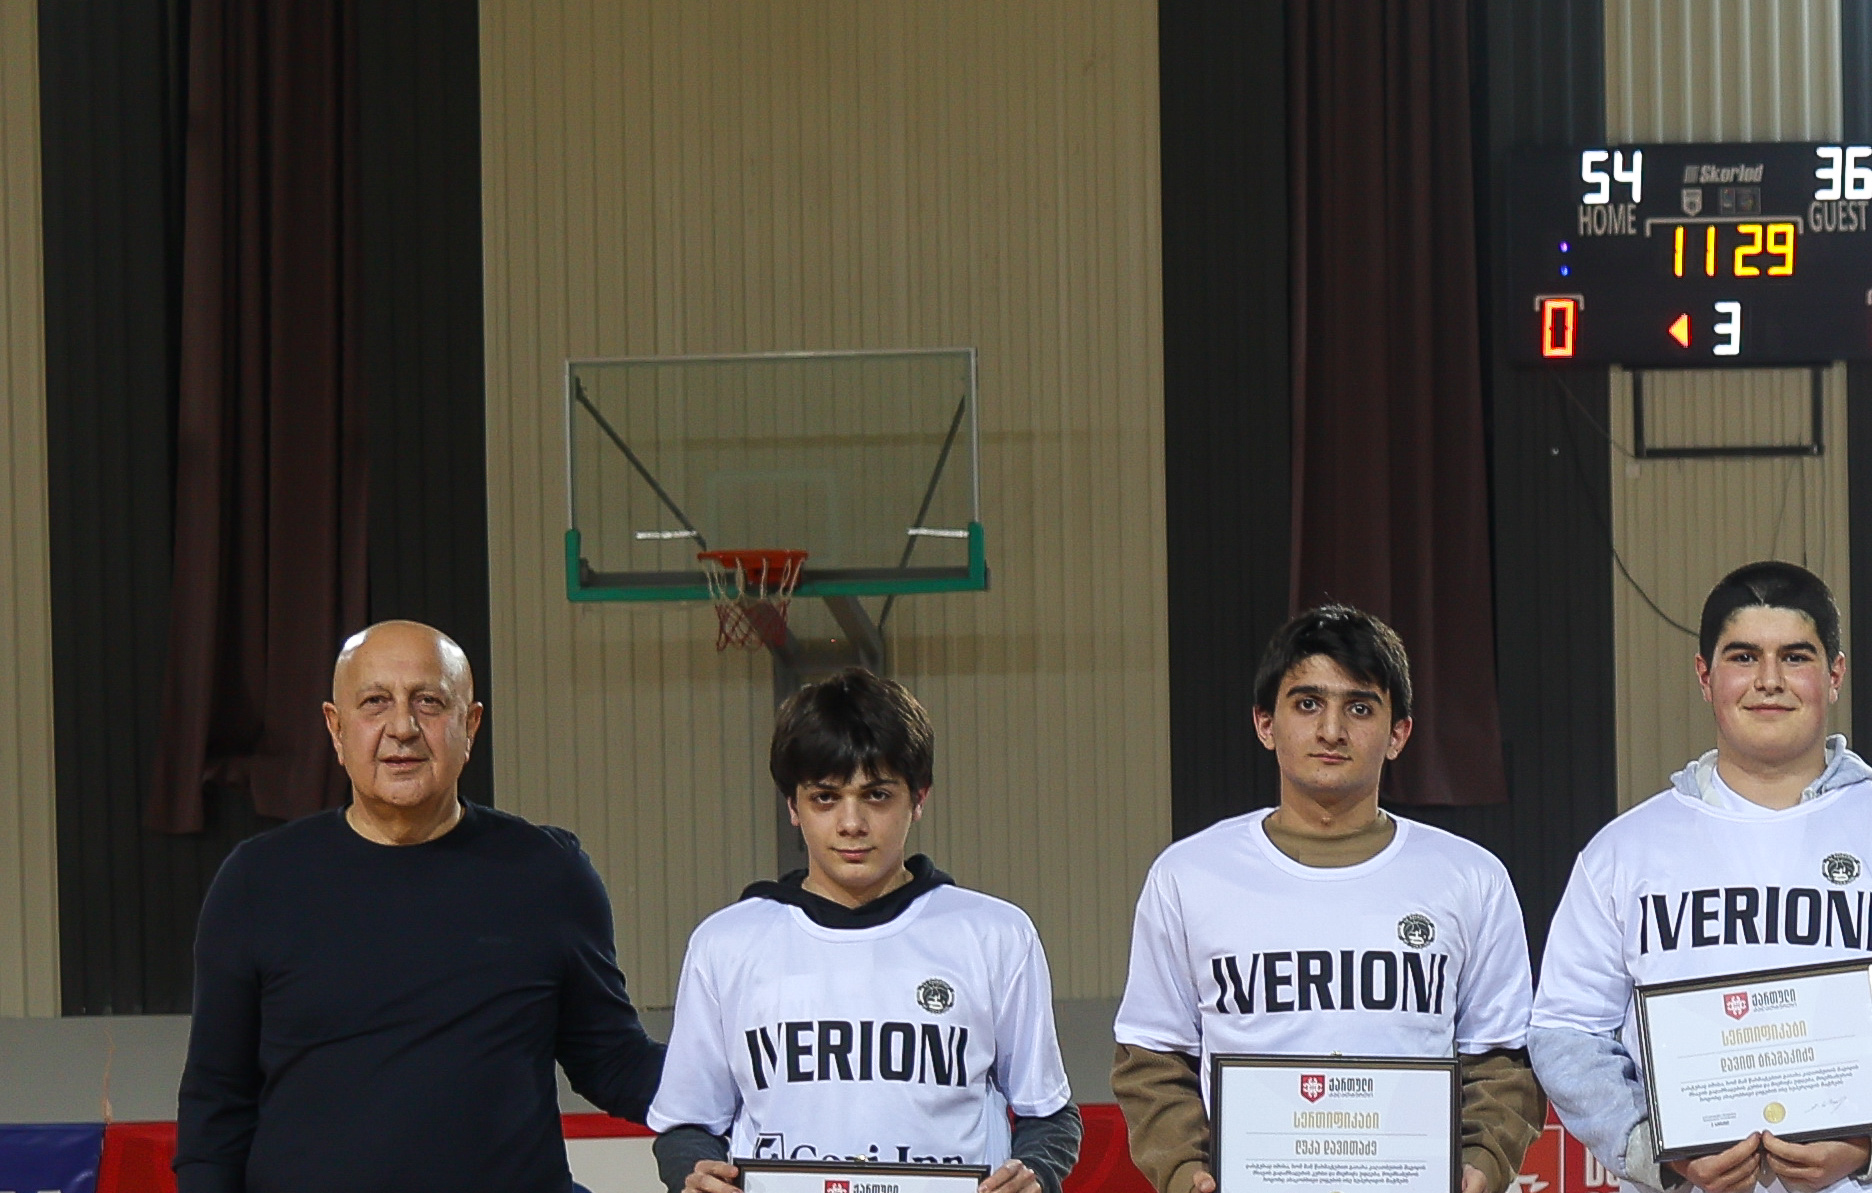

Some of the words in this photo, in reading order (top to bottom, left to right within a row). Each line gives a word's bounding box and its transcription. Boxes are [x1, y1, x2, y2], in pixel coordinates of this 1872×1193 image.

[1581, 150, 1643, 204] 54
[1577, 205, 1637, 236] HOME
[1807, 201, 1868, 232] GUEST
[1542, 299, 1577, 358] 0
[1713, 300, 1742, 356] 3
[1211, 950, 1448, 1015] IVERIONI
[745, 1020, 968, 1090] IVERIONI
